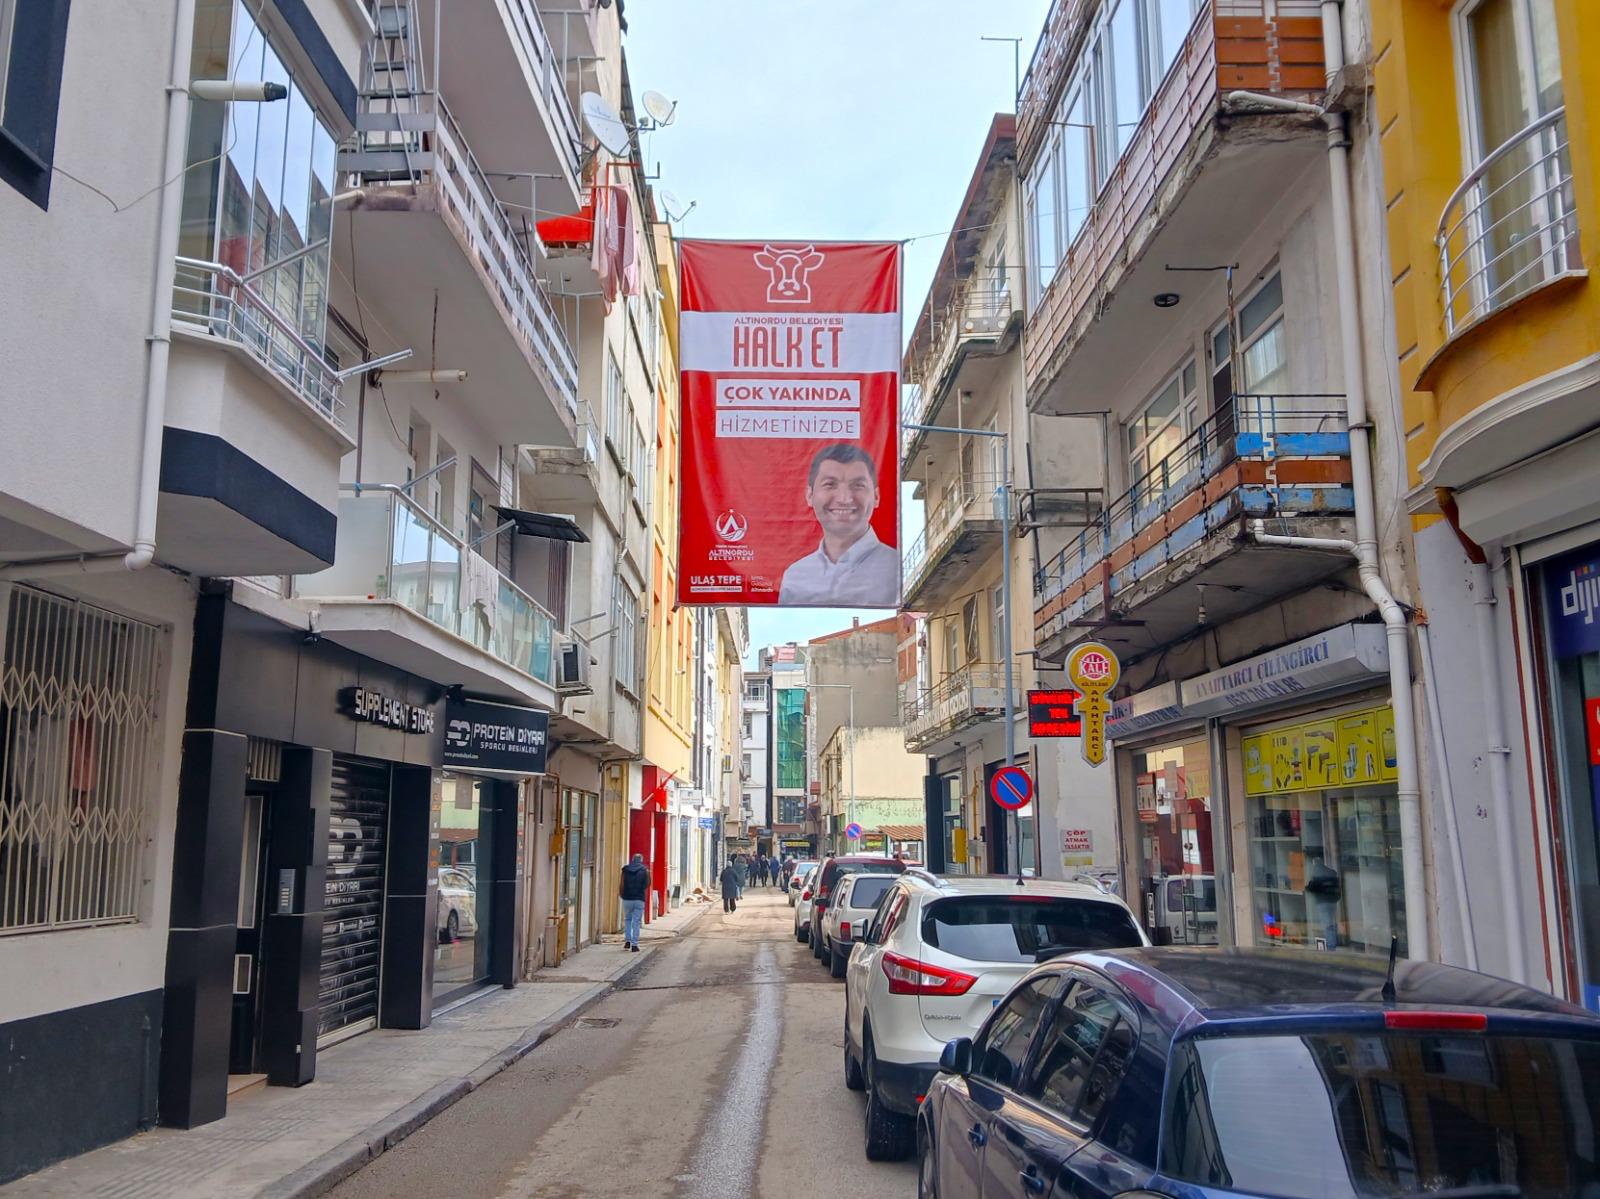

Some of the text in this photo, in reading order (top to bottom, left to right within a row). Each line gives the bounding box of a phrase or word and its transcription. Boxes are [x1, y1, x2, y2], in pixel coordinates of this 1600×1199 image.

[735, 316, 787, 325] ALTINORDU
[733, 326, 844, 368] HALK ET
[724, 386, 852, 404] ÇOK YAKINDA
[721, 414, 854, 434] HİZMETİNİZDE
[690, 575, 716, 586] ULAŞ
[717, 575, 742, 585] TEPE
[1079, 660, 1110, 675] KALE
[1196, 637, 1329, 698] ANAHTARCI ÇİLİNGİRCİ
[354, 688, 410, 729] SUPPLEMENT
[411, 705, 434, 734] STORE
[1090, 689, 1100, 757] ANAHTARCI
[473, 722, 515, 742] PROTEİN
[517, 728, 545, 746] DİYARI
[480, 741, 506, 751] SPORCU
